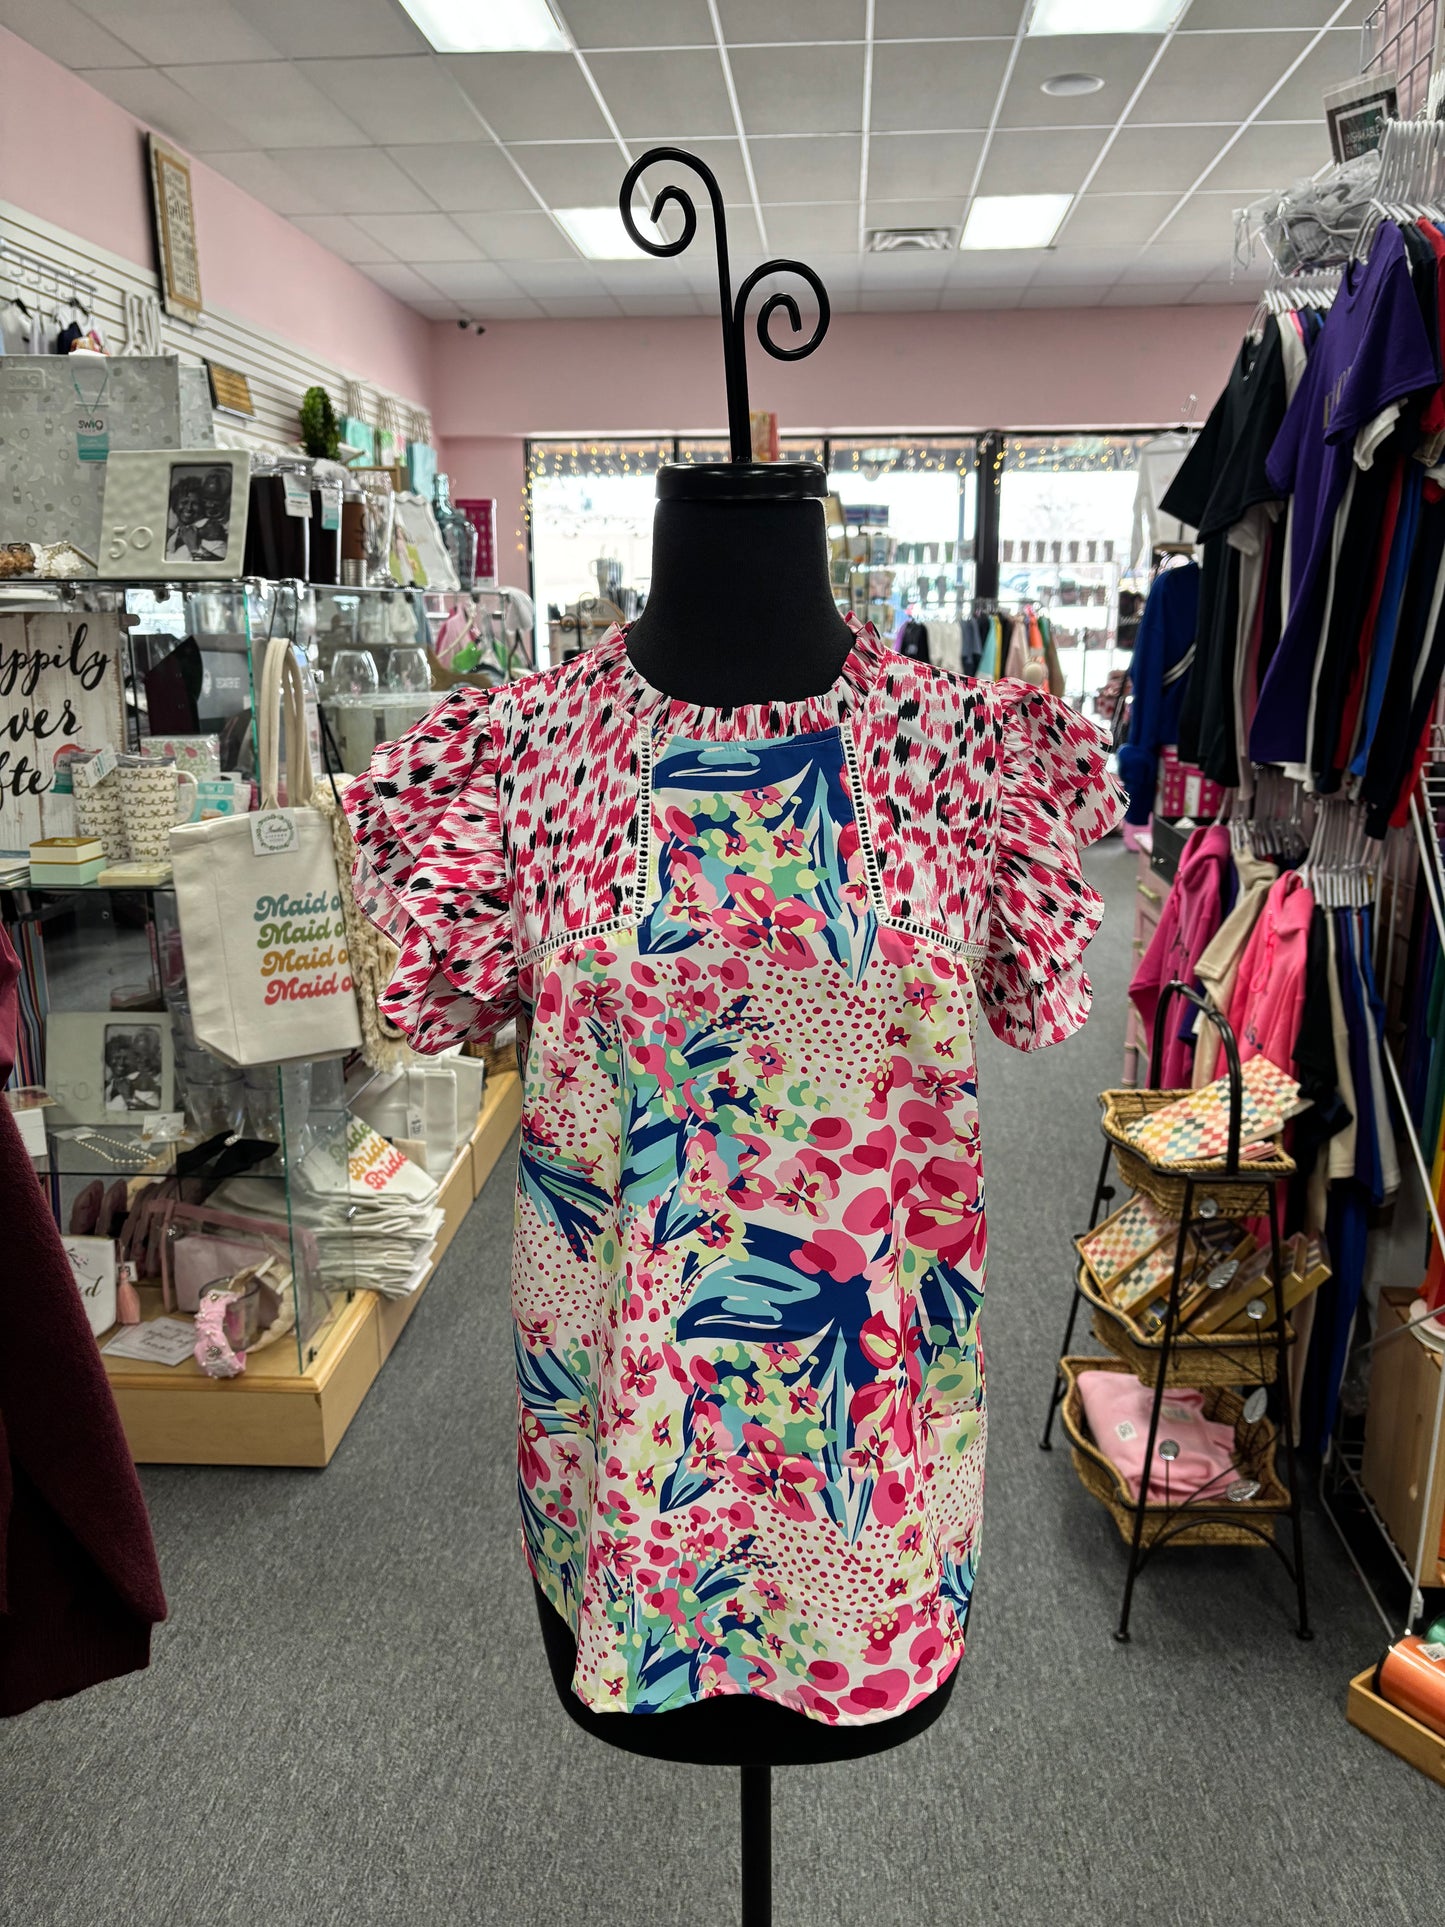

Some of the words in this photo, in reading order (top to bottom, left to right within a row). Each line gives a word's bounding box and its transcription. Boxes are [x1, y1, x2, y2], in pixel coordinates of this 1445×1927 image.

[109, 525, 154, 559] 50
[0, 622, 111, 697] ppily
[0, 699, 82, 742] ver
[254, 890, 328, 922] Maid
[331, 895, 341, 912] o
[257, 917, 332, 949] Maid
[334, 921, 345, 938] o
[260, 944, 336, 977] Maid
[337, 948, 349, 965] o
[264, 972, 339, 1006] Maid
[341, 976, 354, 992] o
[348, 1136, 389, 1181] Bride
[364, 1150, 408, 1190] Bride
